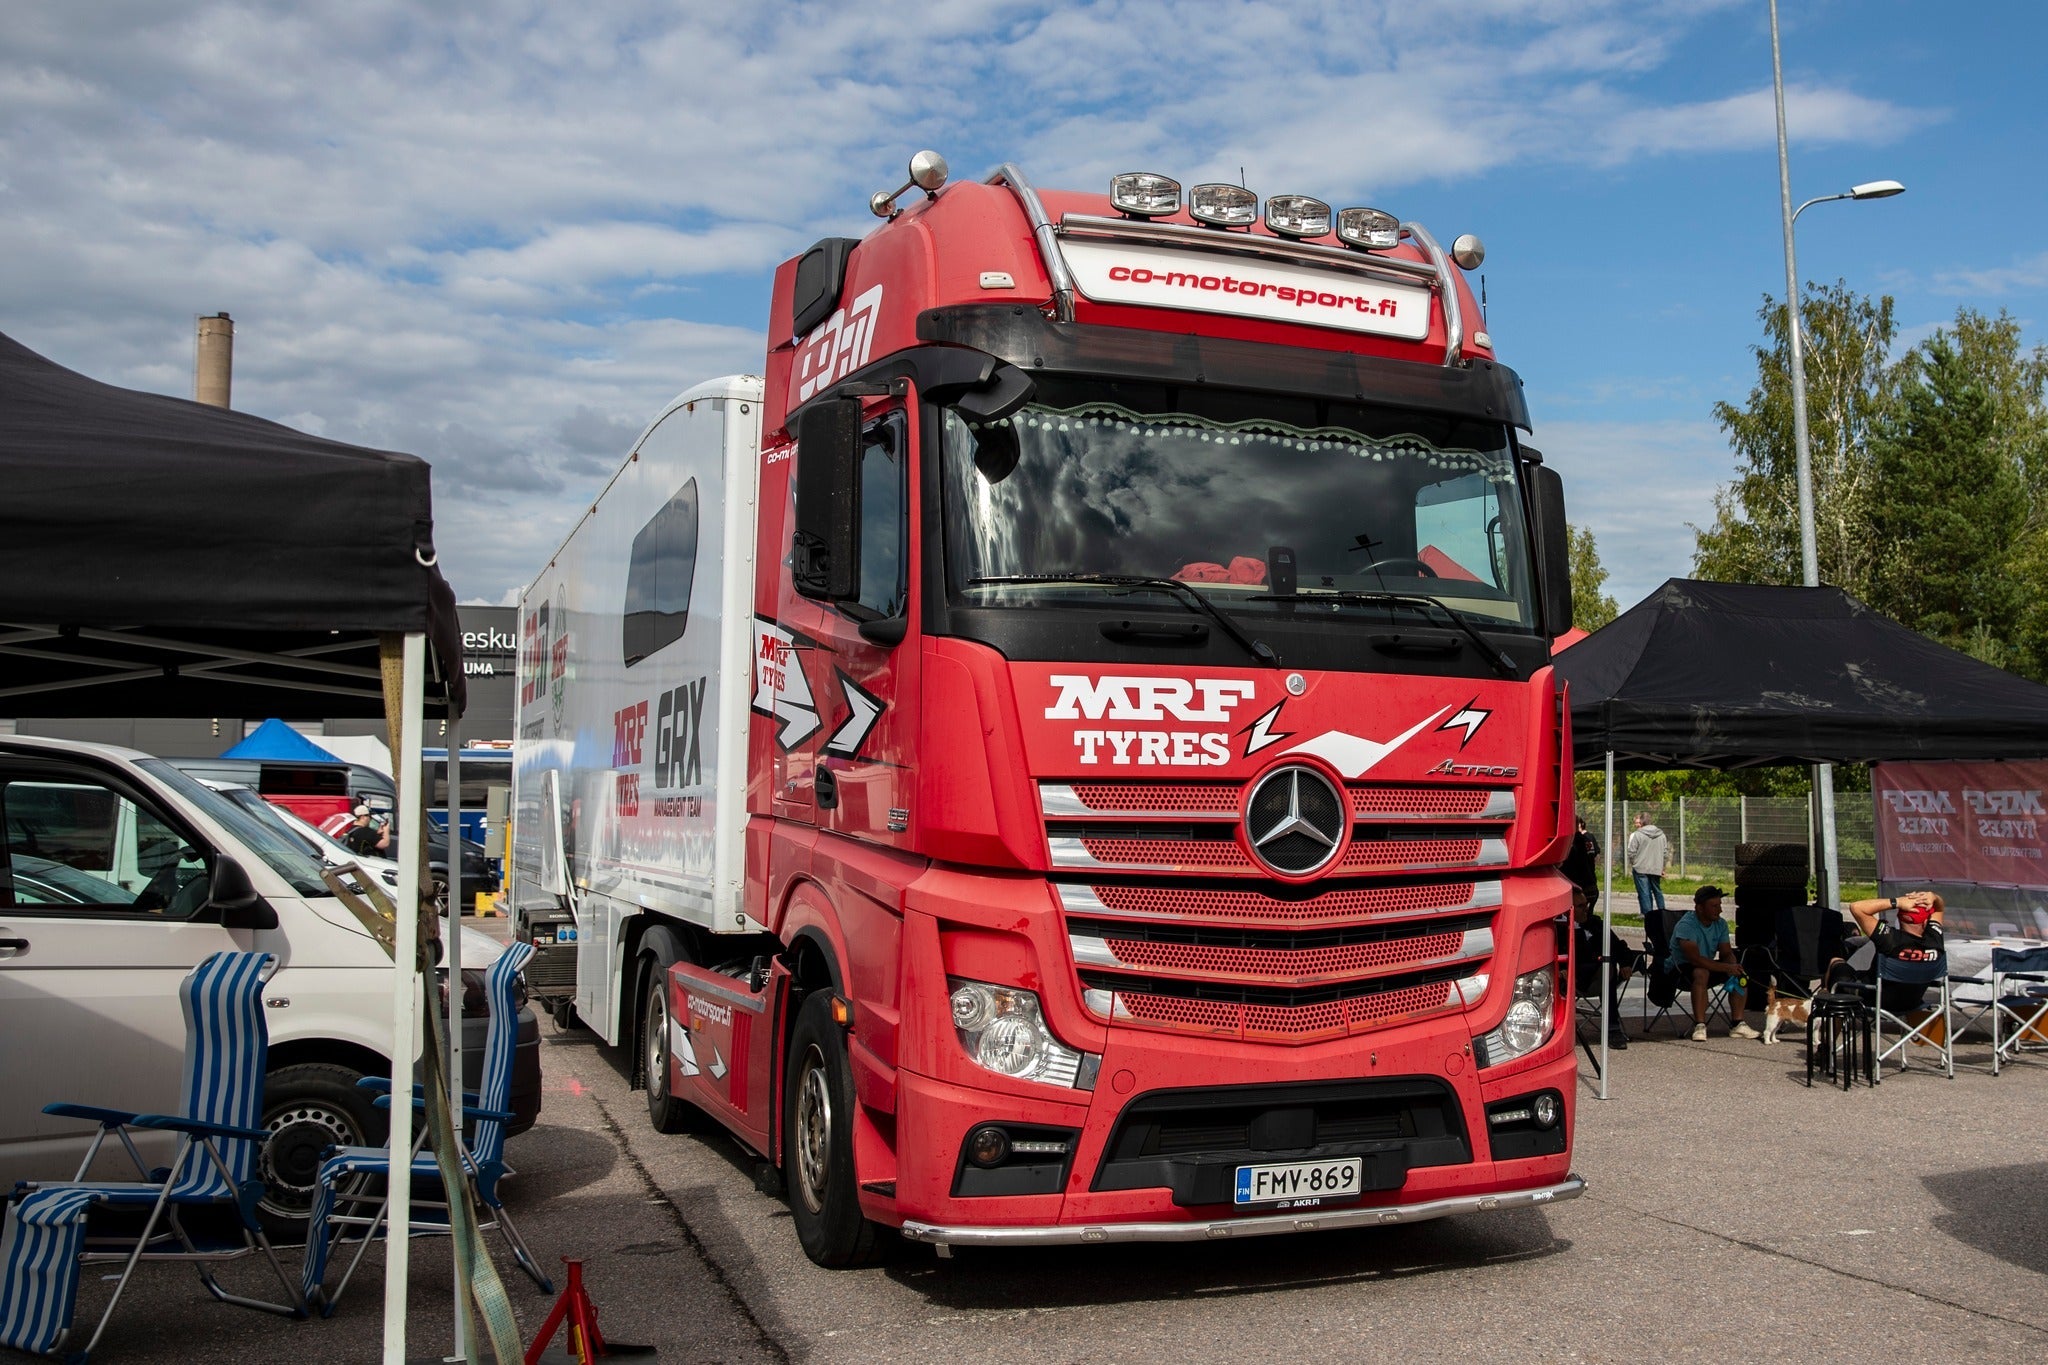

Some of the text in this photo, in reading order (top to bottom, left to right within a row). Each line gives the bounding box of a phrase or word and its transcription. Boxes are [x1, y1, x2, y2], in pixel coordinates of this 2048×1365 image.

[1108, 266, 1397, 318] co-motorsport.fi
[460, 627, 516, 649] esku
[759, 634, 791, 667] MRF
[762, 666, 786, 692] TYRES
[1044, 675, 1256, 723] MRF
[612, 700, 648, 768] MRF
[655, 676, 707, 789] GRX
[1073, 730, 1231, 766] TYRES
[654, 795, 702, 817] MANAGEMENT TEAM
[687, 994, 732, 1027] co-motorsport.fi
[1238, 1165, 1354, 1196] FIN FMV-869
[1293, 1198, 1320, 1207] AKR.FI
